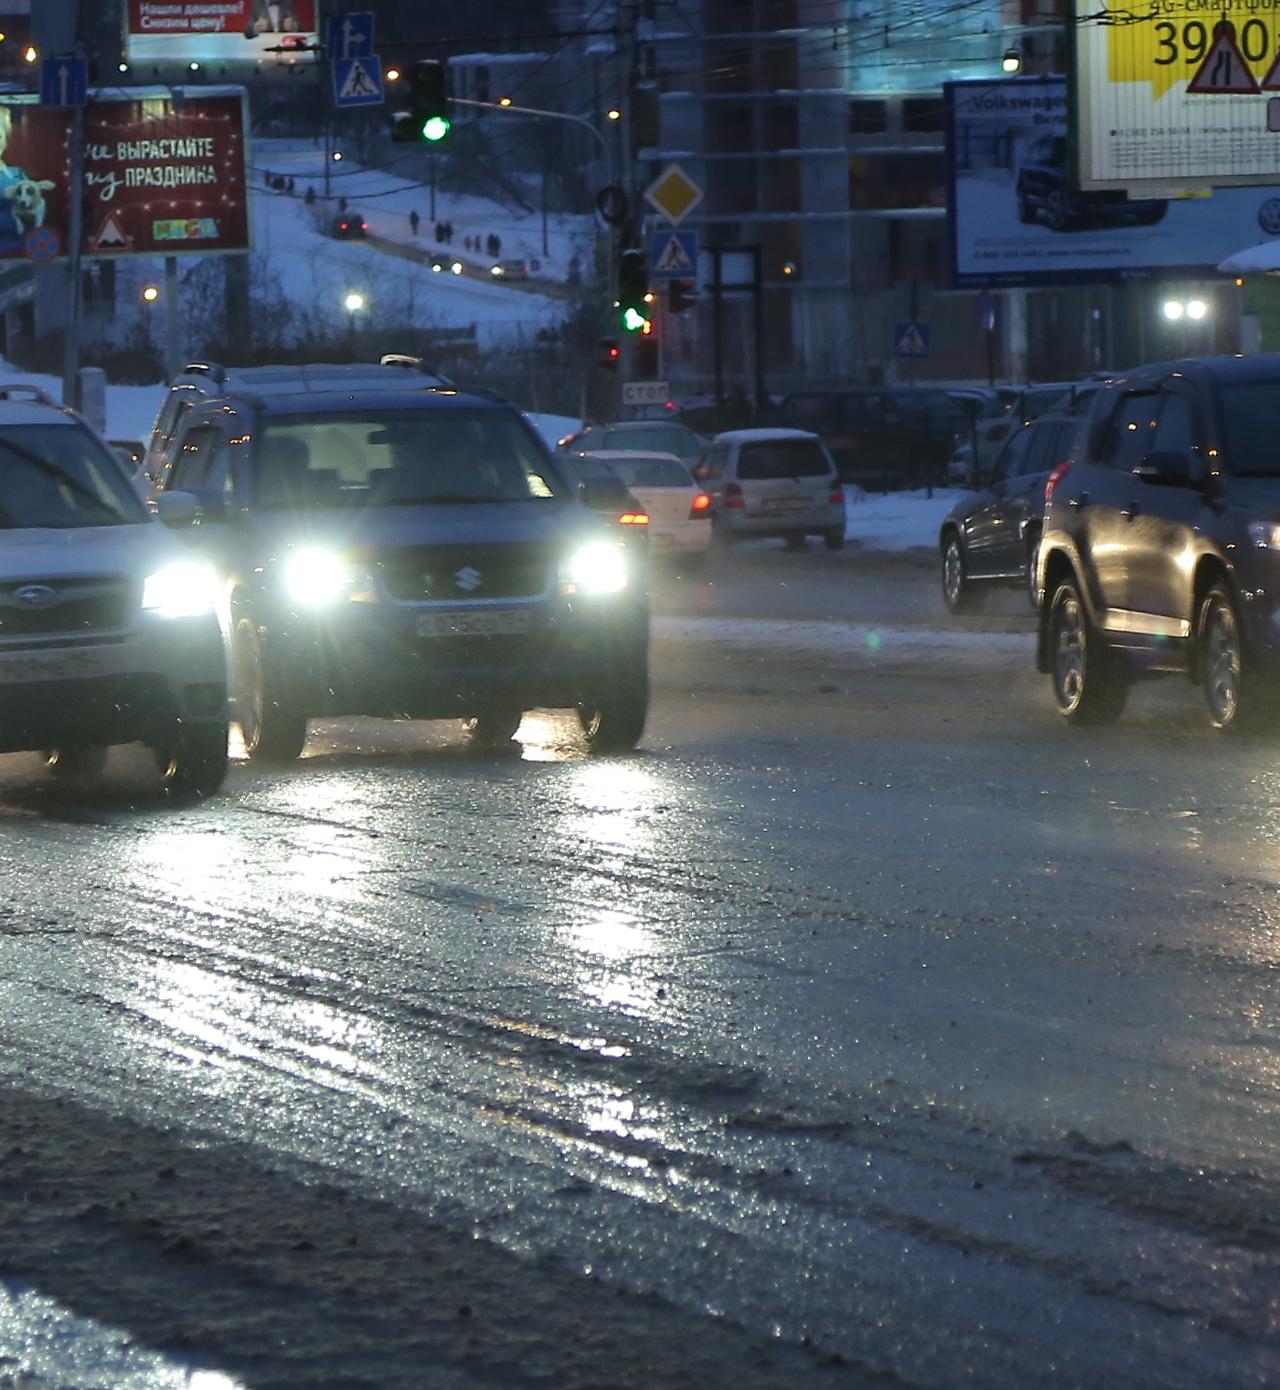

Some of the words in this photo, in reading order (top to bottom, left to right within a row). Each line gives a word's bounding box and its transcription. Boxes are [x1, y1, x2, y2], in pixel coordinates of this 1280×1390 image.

[139, 3, 182, 15] Нашли
[183, 1, 244, 16] дешевле?
[140, 15, 189, 29] Снизим
[190, 15, 226, 32] цену!
[971, 94, 1066, 111] Volkswage
[84, 169, 124, 202] из
[124, 165, 218, 188] ПРАЗДНИКА
[625, 386, 668, 400] СТОП
